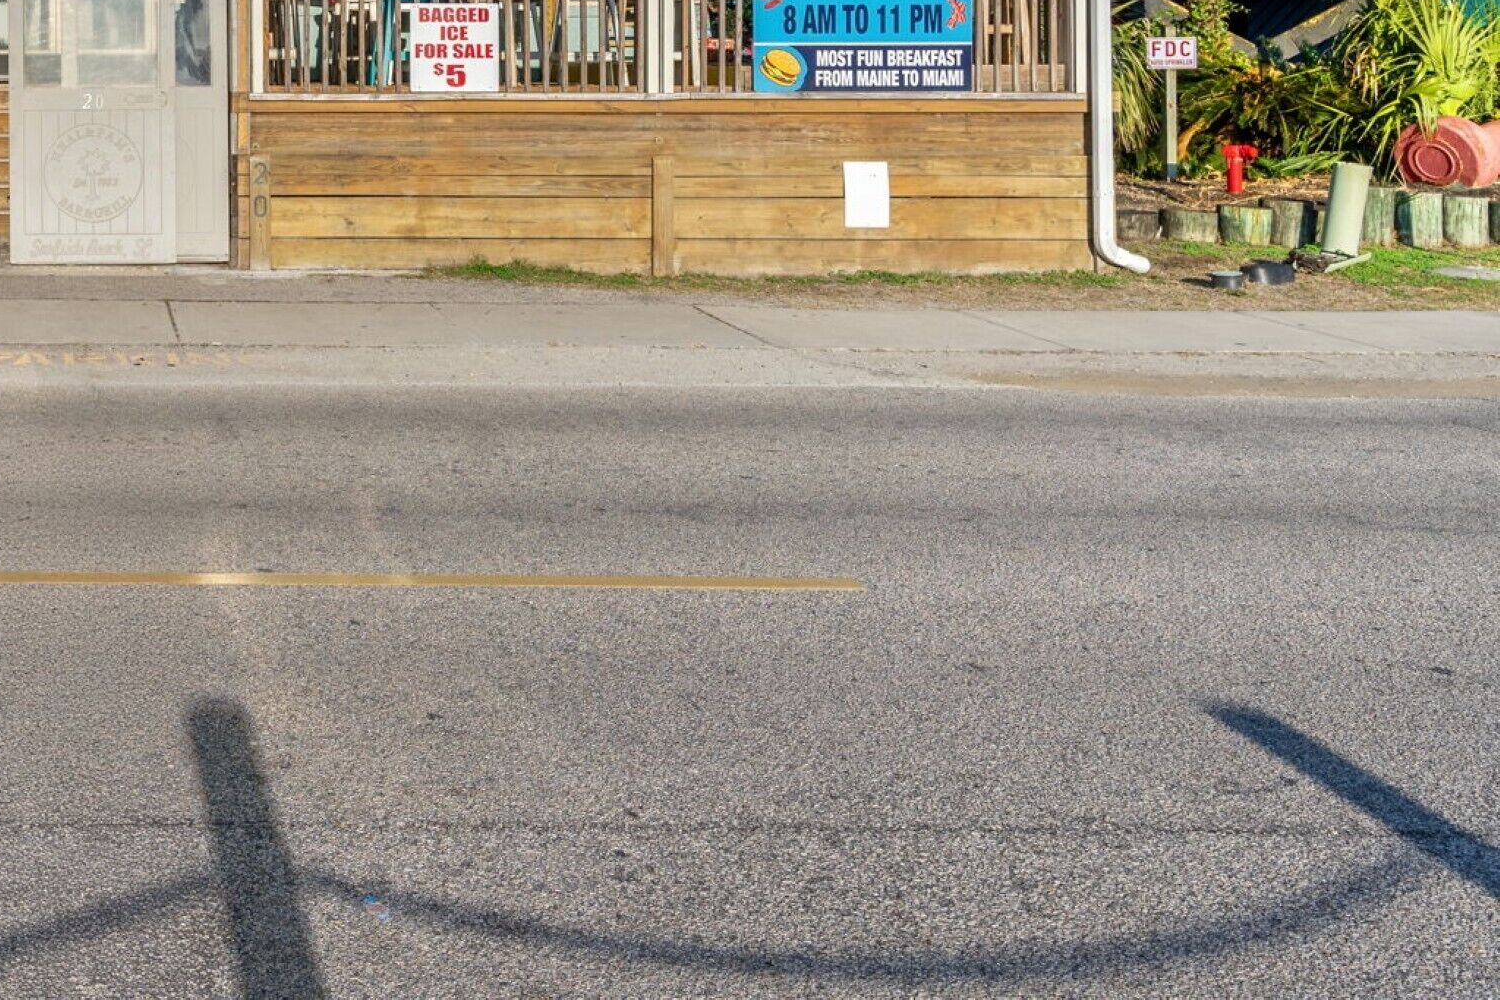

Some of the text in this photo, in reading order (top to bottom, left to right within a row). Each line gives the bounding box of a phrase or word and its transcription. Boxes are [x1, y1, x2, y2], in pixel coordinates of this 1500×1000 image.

[419, 7, 489, 22] BAGGED
[784, 4, 943, 34] 8 AM TO 11 PM
[440, 26, 468, 41] ICE
[415, 43, 493, 59] FOR SALE
[1152, 41, 1190, 57] FDC
[816, 50, 963, 66] MOST FUN BREAKFAST
[815, 70, 964, 87] FROM MAINE TO MIAMI
[82, 93, 104, 109] 20
